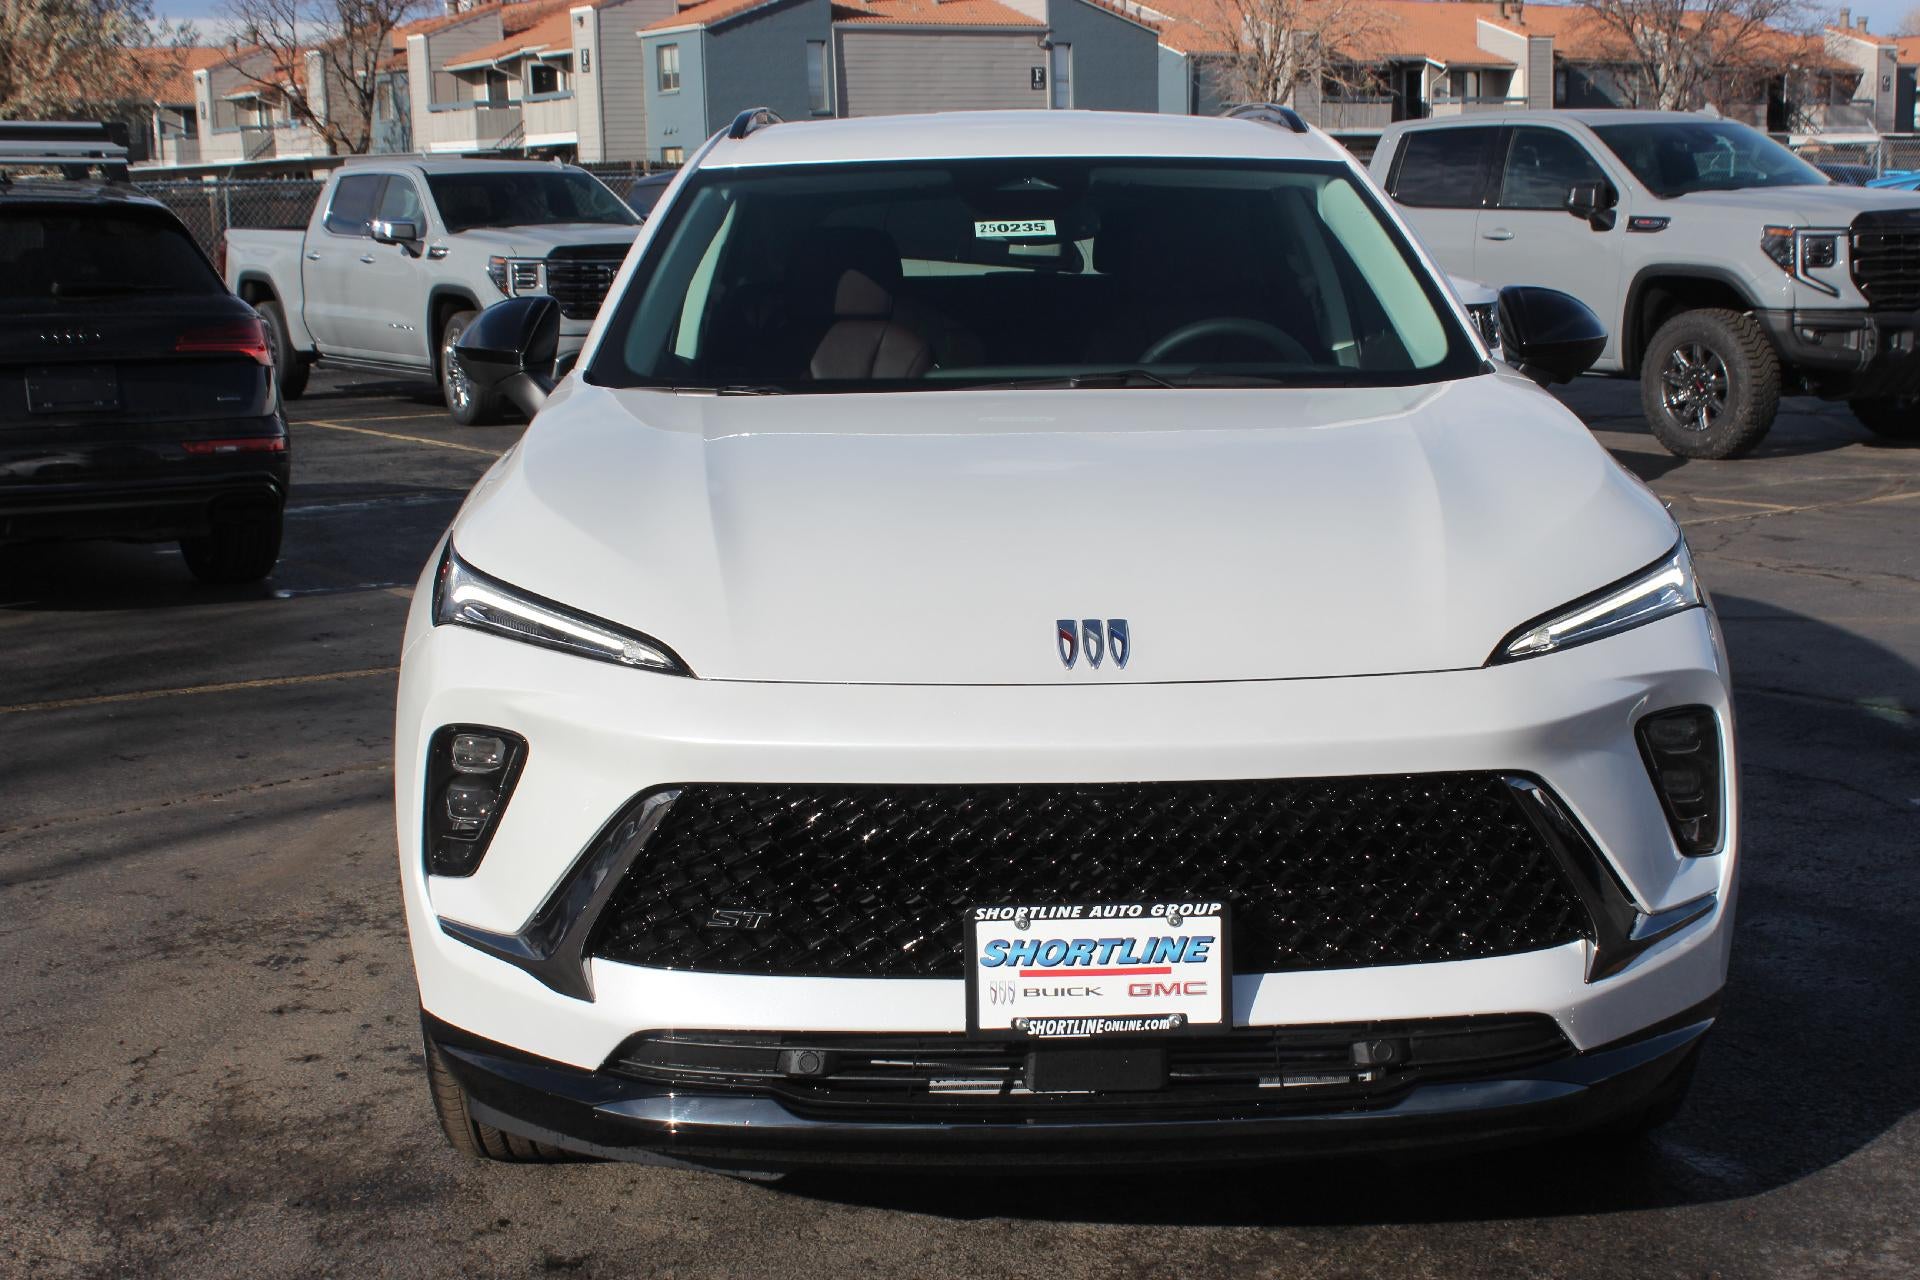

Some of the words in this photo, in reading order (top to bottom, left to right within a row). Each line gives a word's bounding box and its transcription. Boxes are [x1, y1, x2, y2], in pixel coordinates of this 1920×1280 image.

[1034, 68, 1043, 81] F
[979, 222, 1047, 233] 250235
[974, 906, 1083, 920] SHORTLINE
[1088, 905, 1143, 917] AUTO
[1150, 903, 1222, 917] GROUP
[979, 936, 1216, 968] SHORTLINE
[1023, 986, 1104, 997] BUICK
[1128, 981, 1208, 997] GMC
